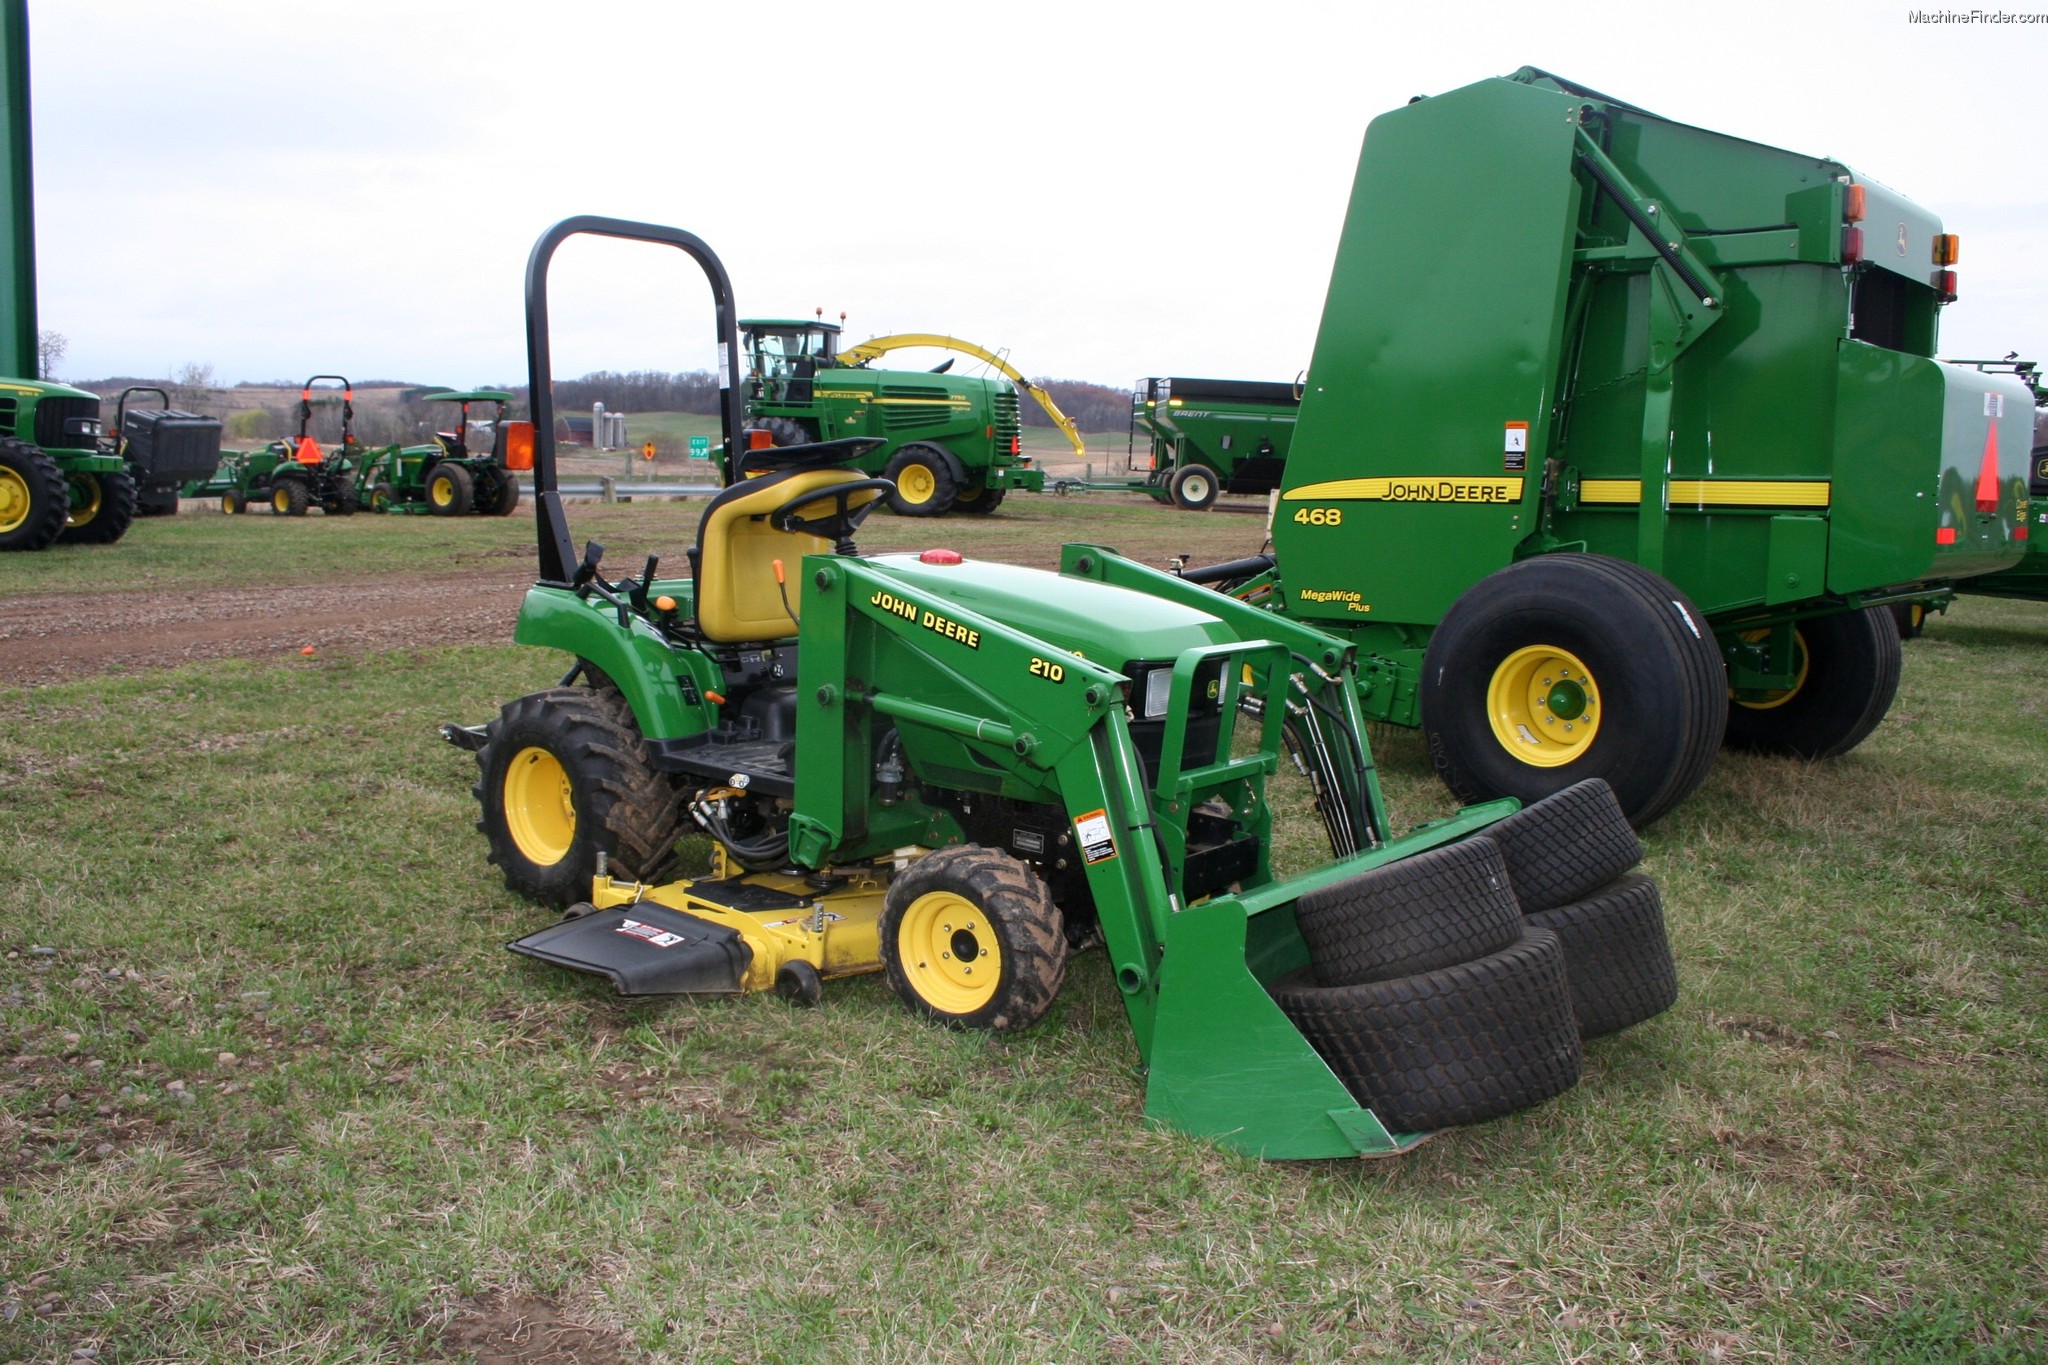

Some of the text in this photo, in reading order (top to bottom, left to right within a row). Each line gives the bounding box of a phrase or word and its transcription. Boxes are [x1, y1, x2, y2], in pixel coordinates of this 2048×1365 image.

[1172, 410, 1211, 418] BRENT
[690, 448, 701, 456] 99
[1381, 481, 1509, 502] JOHN DEERE
[1293, 507, 1342, 526] 468
[1300, 589, 1362, 603] MegaWide
[1347, 602, 1371, 613] Plus
[870, 591, 980, 650] JOHN DEERE
[1029, 656, 1065, 684] 210
